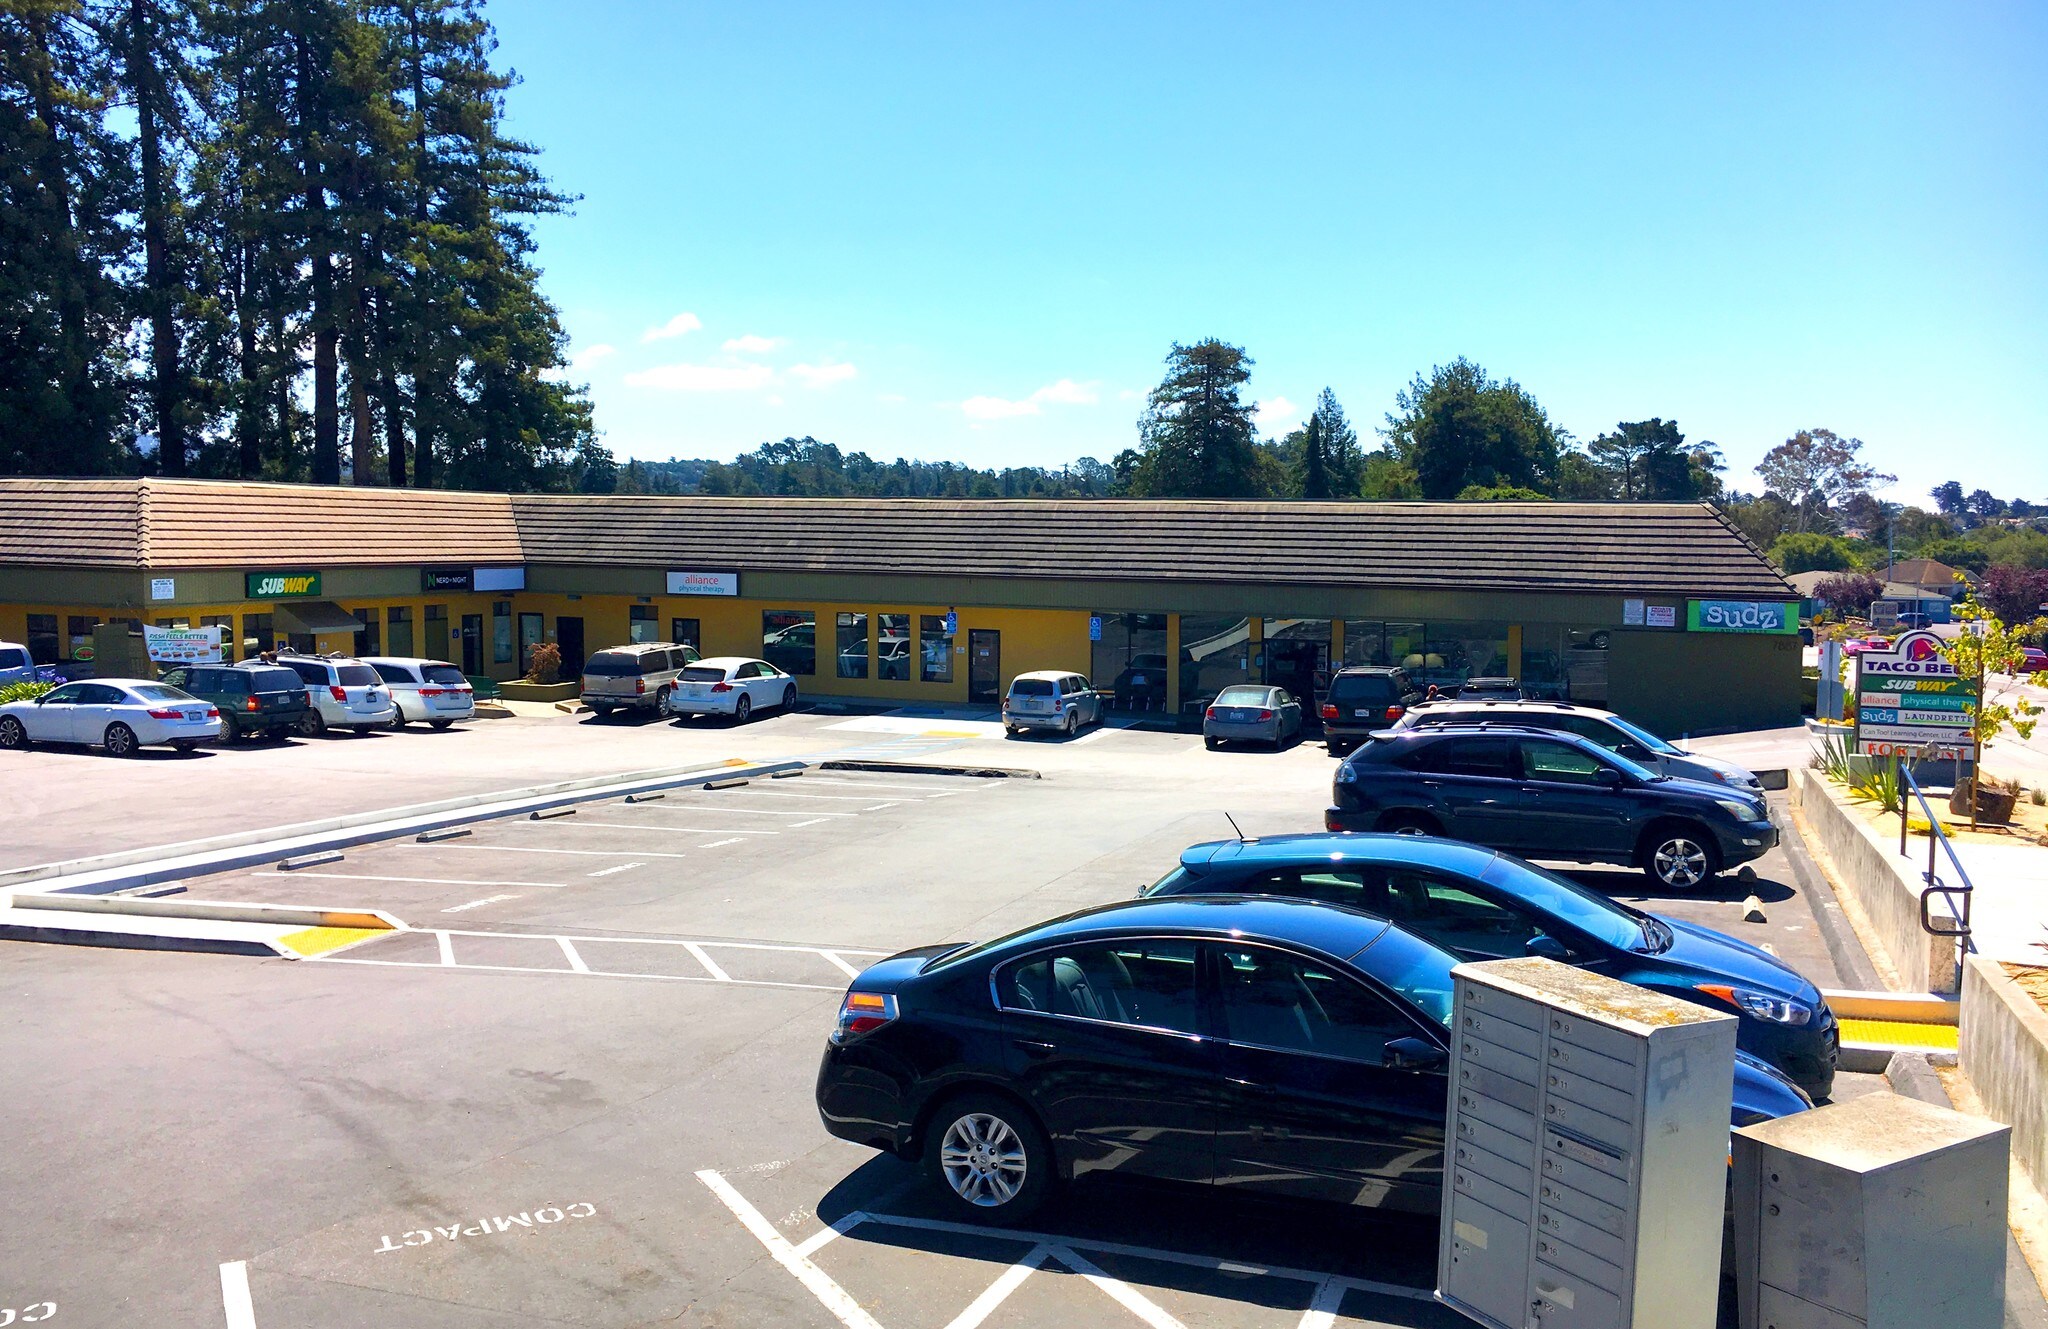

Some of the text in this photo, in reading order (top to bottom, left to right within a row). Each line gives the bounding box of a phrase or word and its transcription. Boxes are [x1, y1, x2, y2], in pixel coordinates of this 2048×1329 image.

[684, 574, 719, 585] alliance
[257, 576, 315, 594] SUBWAY
[679, 585, 702, 593] physical
[1707, 602, 1778, 629] sudz
[1866, 661, 1961, 674] TACO BEL
[1881, 680, 1957, 692] SUBWAY
[1861, 696, 1975, 707] alliance physical ther
[1861, 710, 1895, 722] sudz
[1904, 713, 1973, 722] LAUNDRETTE
[1890, 730, 1917, 738] Learning
[1564, 1024, 1570, 1033] 9
[1561, 1053, 1570, 1062] 10
[1560, 1080, 1568, 1089] 11
[1558, 1108, 1566, 1117] 12
[1554, 1164, 1563, 1174] 13
[1553, 1192, 1561, 1201] 14
[374, 1202, 597, 1253] COMPACT
[1551, 1219, 1560, 1229] 15
[1549, 1247, 1558, 1256] 16
